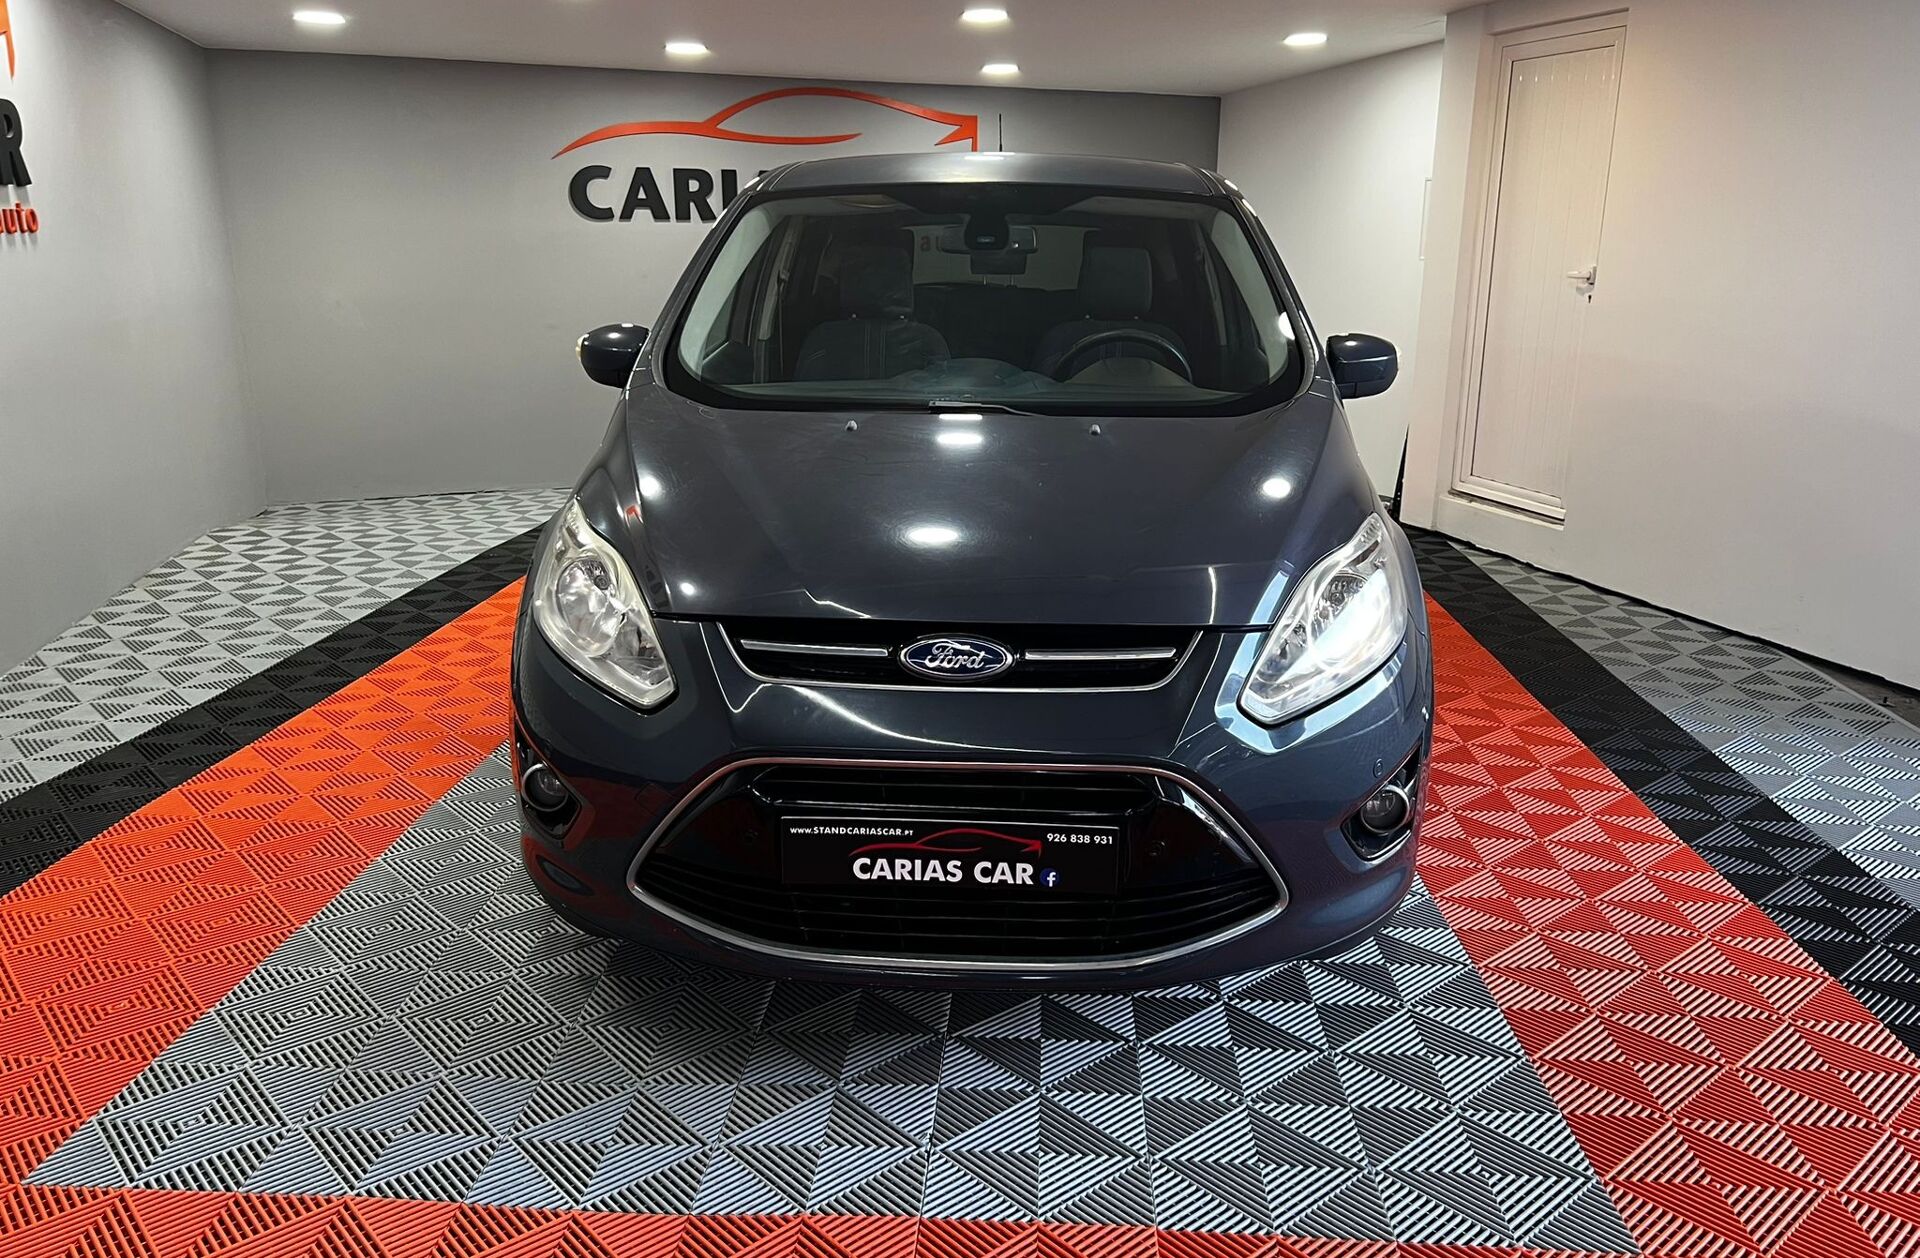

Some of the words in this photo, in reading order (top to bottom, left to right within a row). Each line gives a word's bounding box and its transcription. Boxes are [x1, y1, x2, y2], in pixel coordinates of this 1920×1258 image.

[569, 165, 769, 222] CARI
[925, 641, 984, 668] Ford
[1046, 833, 1067, 843] 926
[1070, 834, 1091, 844] 838
[1094, 835, 1113, 845] 931
[852, 857, 963, 883] CARIAS
[973, 861, 1034, 885] CAR
